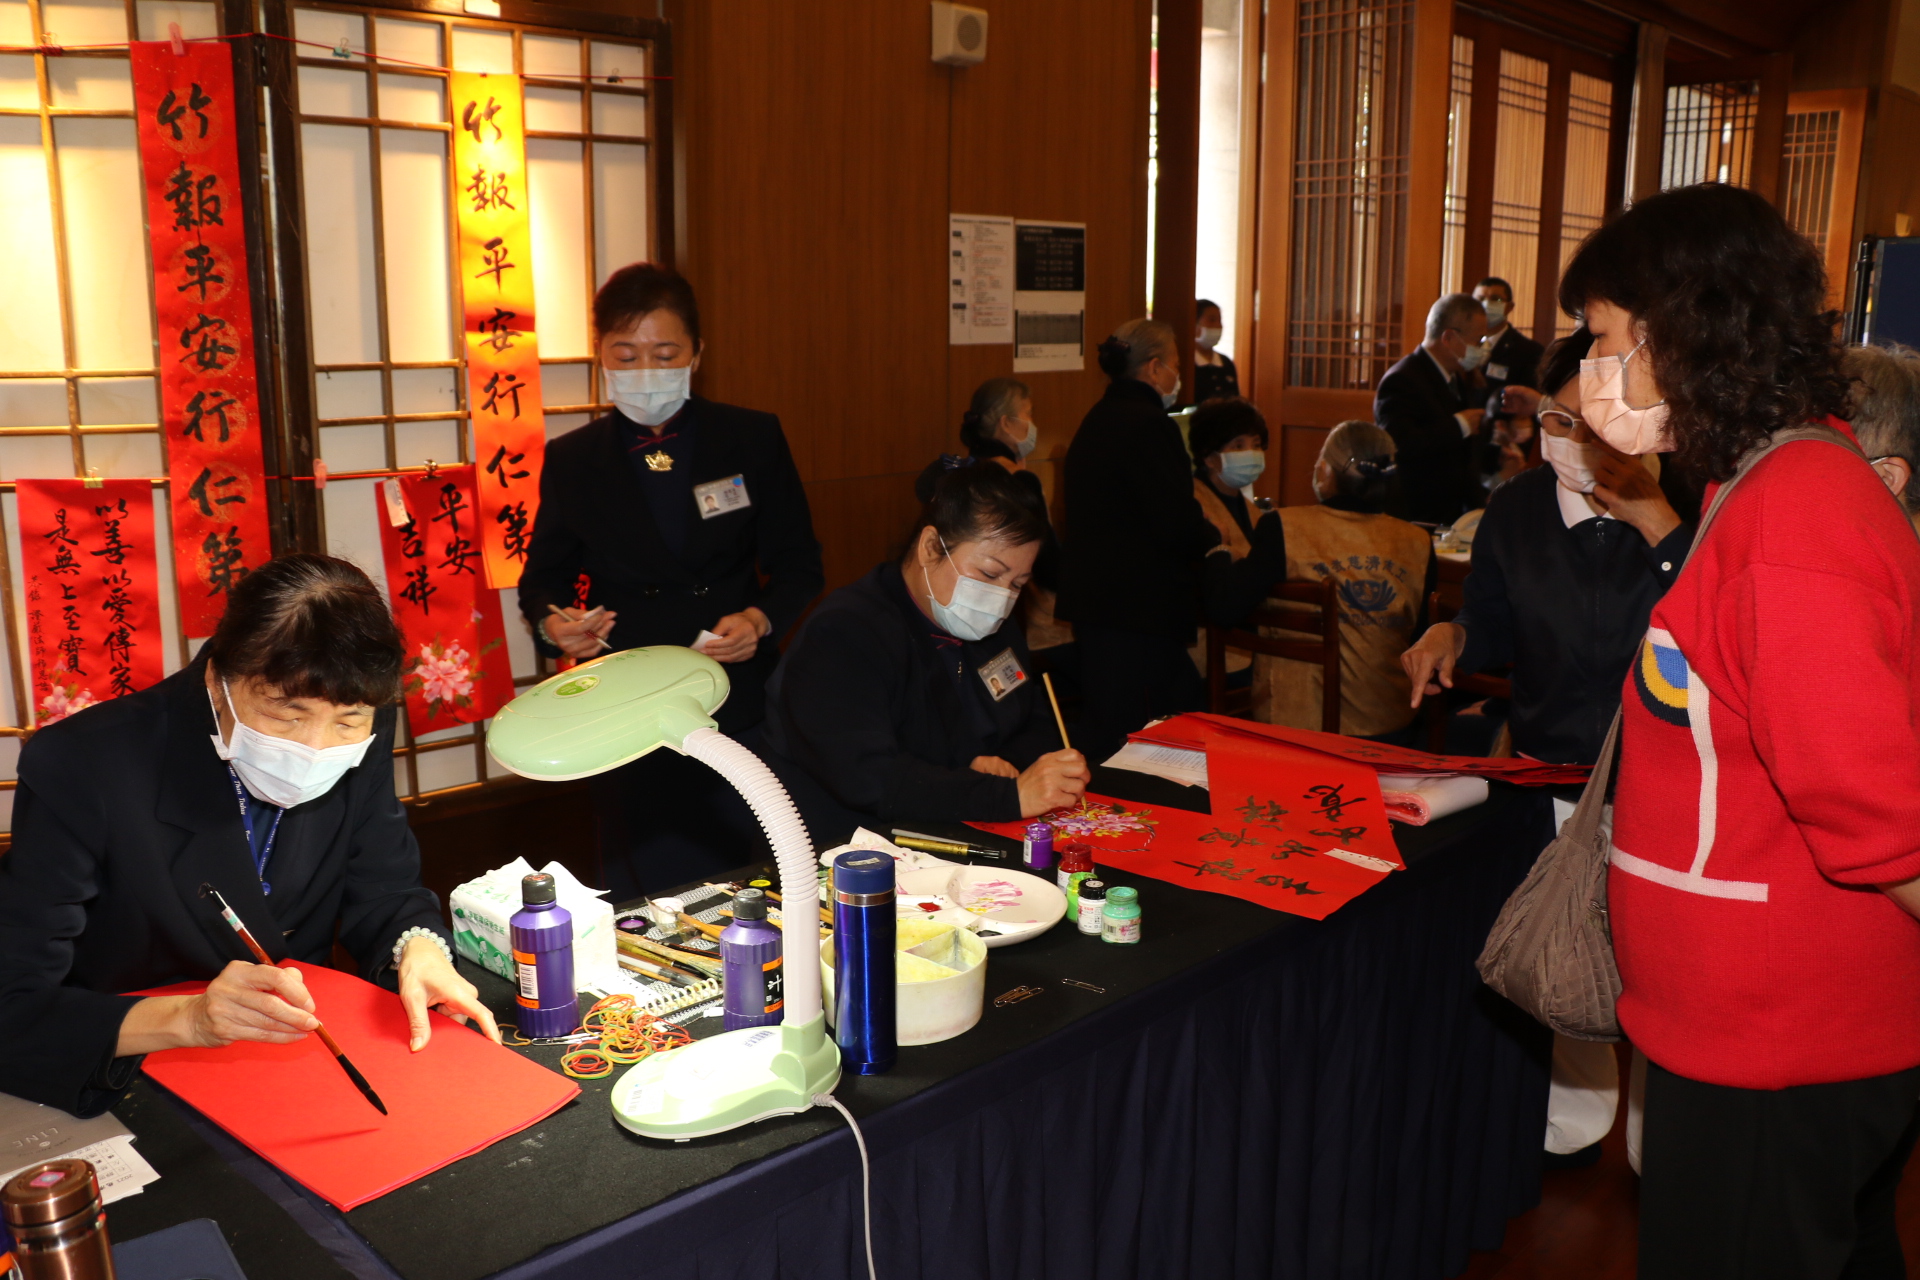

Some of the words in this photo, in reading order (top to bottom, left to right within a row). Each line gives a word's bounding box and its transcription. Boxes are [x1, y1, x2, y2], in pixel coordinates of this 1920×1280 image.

[156, 83, 249, 598] 竹報平安行仁第
[463, 96, 534, 563] 竹報平安行仁第
[44, 508, 87, 677] 是無上至寶
[90, 498, 139, 697] 以善以愛傳家
[398, 512, 437, 616] 吉祥
[431, 483, 482, 576] 平安
[12, 1127, 59, 1148] LINE
